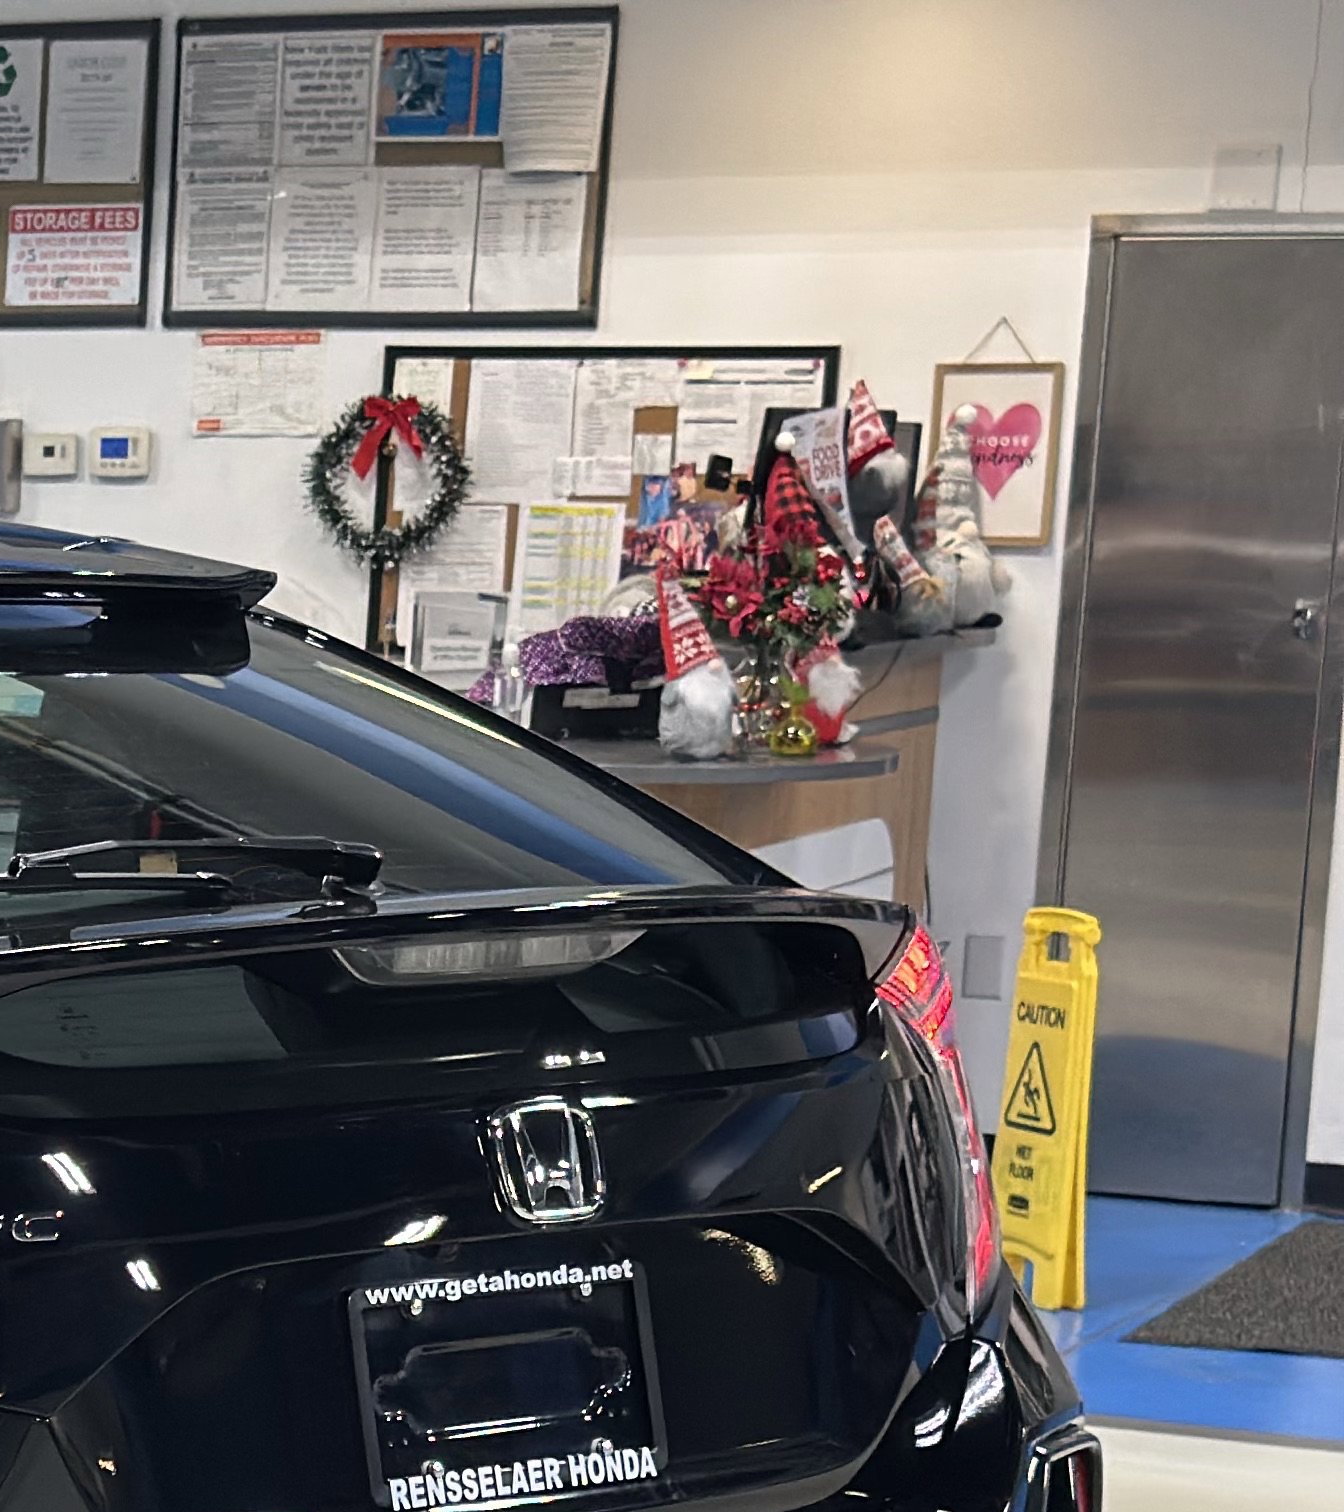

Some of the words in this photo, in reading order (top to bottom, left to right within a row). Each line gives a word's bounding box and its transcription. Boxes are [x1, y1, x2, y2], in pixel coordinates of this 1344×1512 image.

[14, 213, 91, 231] STORAGE
[94, 210, 136, 229] FEES
[974, 435, 1030, 448] HOOSE
[1017, 1001, 1066, 1030] CAUTION
[1008, 1161, 1034, 1182] FLOOR
[364, 1258, 634, 1305] www.getahonda.net
[388, 1458, 565, 1512] RENSSELAER
[568, 1446, 658, 1488] HONDA
